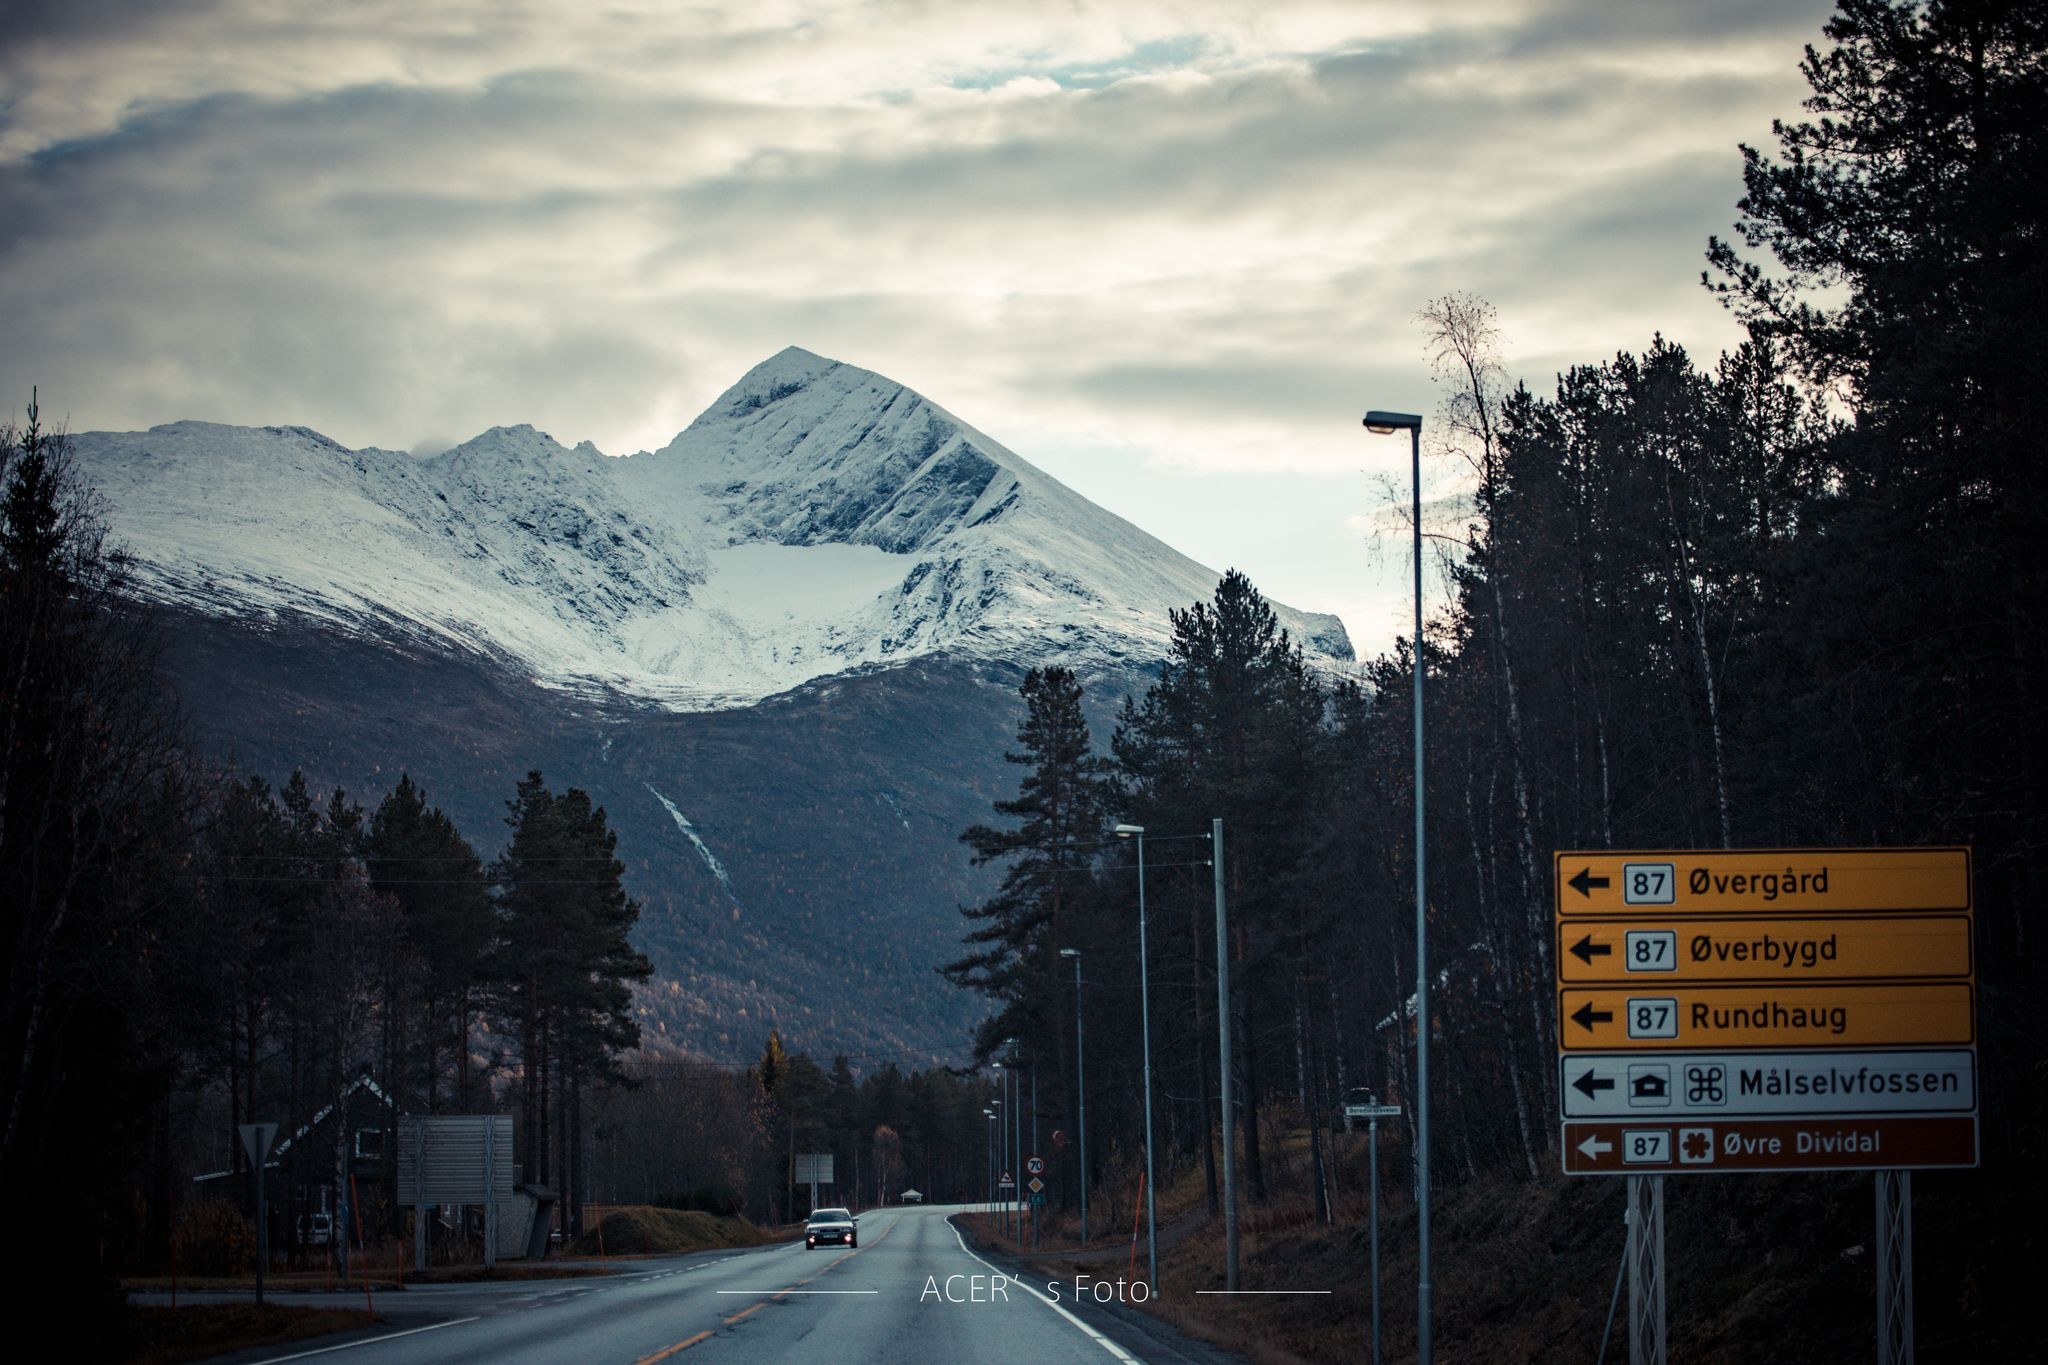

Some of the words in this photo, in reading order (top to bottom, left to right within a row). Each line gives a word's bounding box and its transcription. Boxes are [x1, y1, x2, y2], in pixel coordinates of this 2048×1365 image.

[1633, 873, 1666, 895] 87
[1689, 867, 1829, 900] Øvergård
[1635, 940, 1667, 962] 87
[1690, 934, 1837, 967] Øverbygd
[1636, 1008, 1669, 1030] 87
[1692, 1002, 1847, 1033] Rundhaug
[1740, 1068, 1959, 1095] Målselvfossen
[1634, 1138, 1660, 1156] 87
[1724, 1136, 1782, 1156] Øvre
[1796, 1130, 1880, 1153] Dividal
[1030, 1160, 1042, 1171] 70
